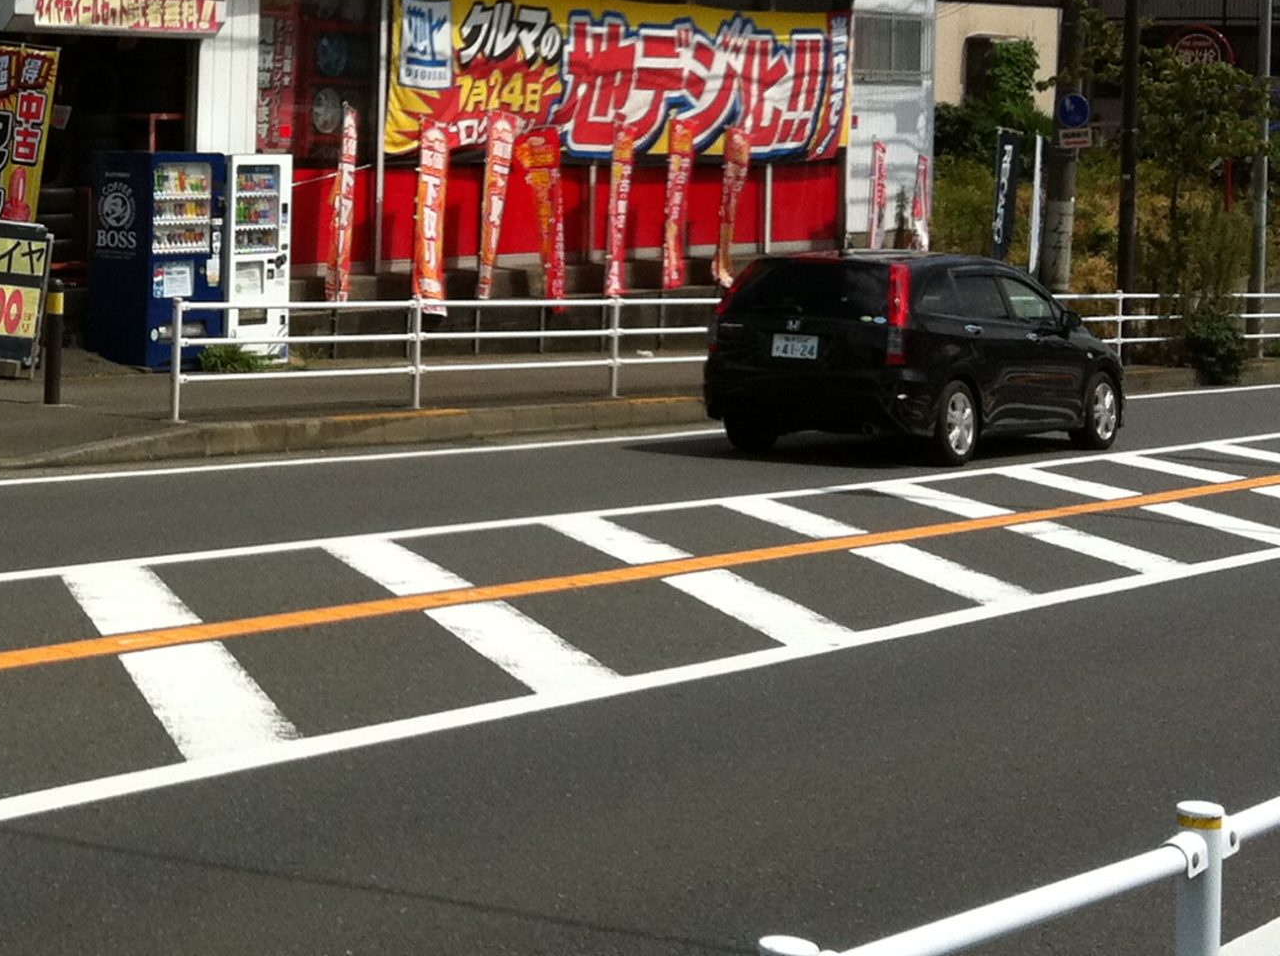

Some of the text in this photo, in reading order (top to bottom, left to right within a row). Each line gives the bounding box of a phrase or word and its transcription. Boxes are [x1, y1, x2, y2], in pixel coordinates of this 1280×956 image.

[460, 0, 562, 67] クルマの
[455, 69, 543, 113] 7月24日
[13, 90, 47, 164] 中古
[993, 145, 1014, 244] RECARO
[96, 229, 137, 249] BOSS
